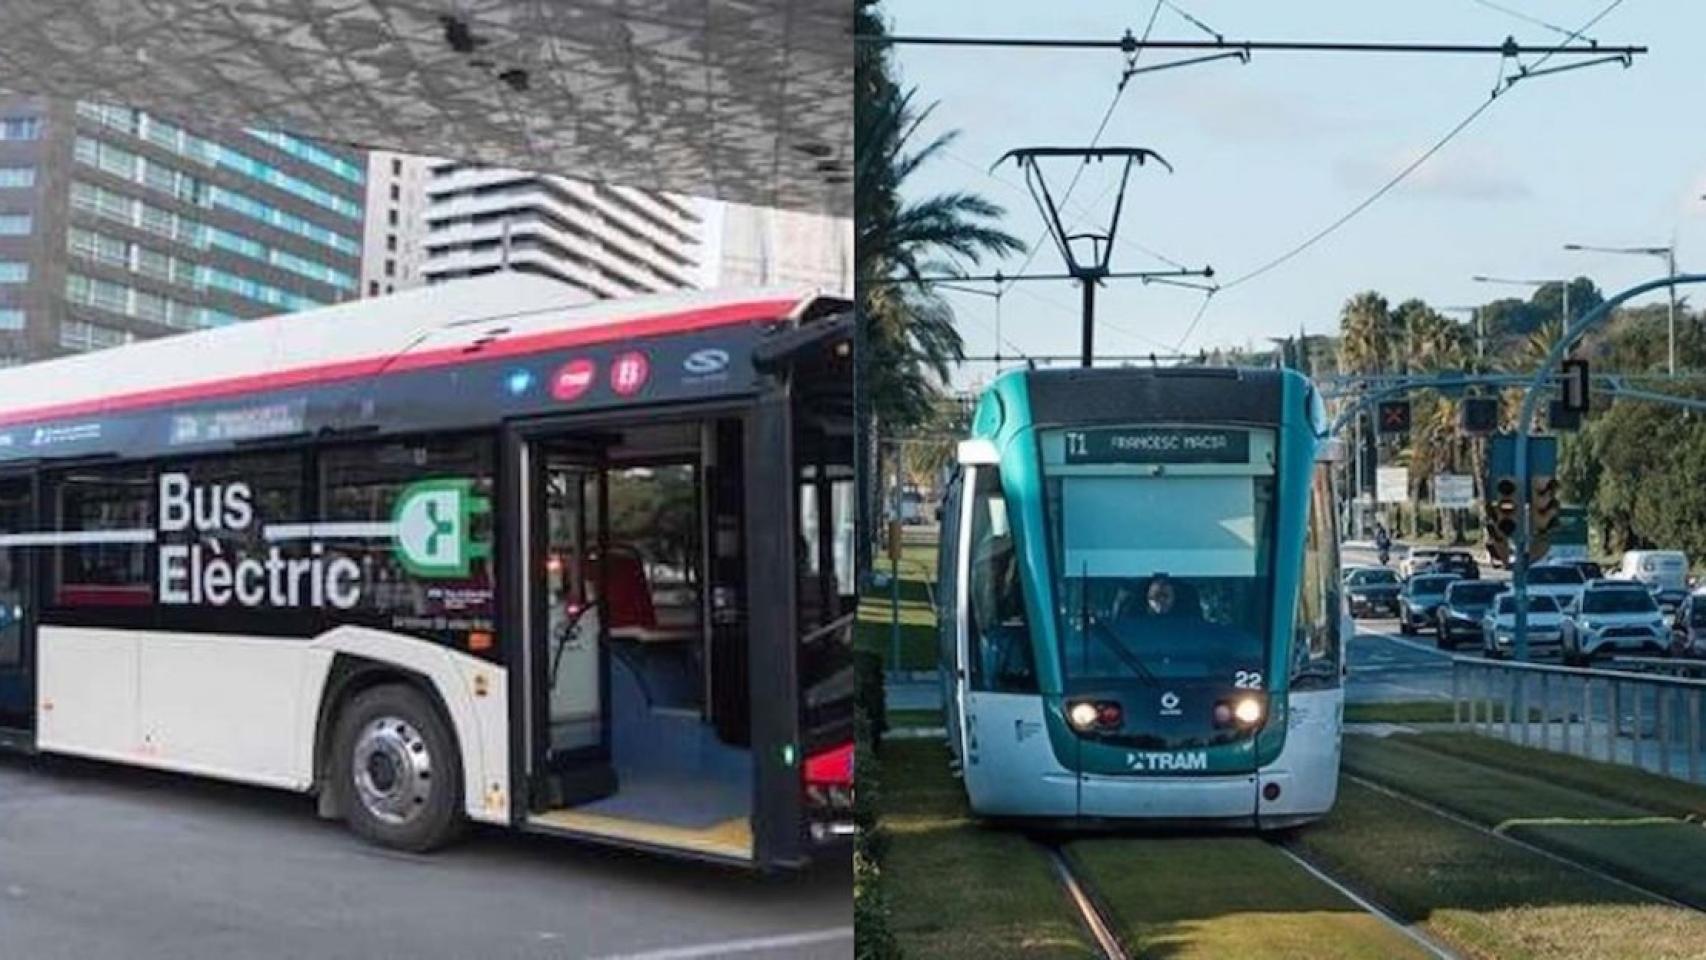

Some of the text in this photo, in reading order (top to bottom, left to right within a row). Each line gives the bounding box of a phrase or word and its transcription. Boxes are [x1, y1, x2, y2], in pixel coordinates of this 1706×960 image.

[1066, 432, 1088, 455] T1
[1111, 435, 1180, 450] FRANCESC
[159, 472, 252, 531] Bus
[159, 537, 361, 609] Elèctric
[1234, 670, 1262, 690] 22
[1146, 751, 1208, 770] TRAM
